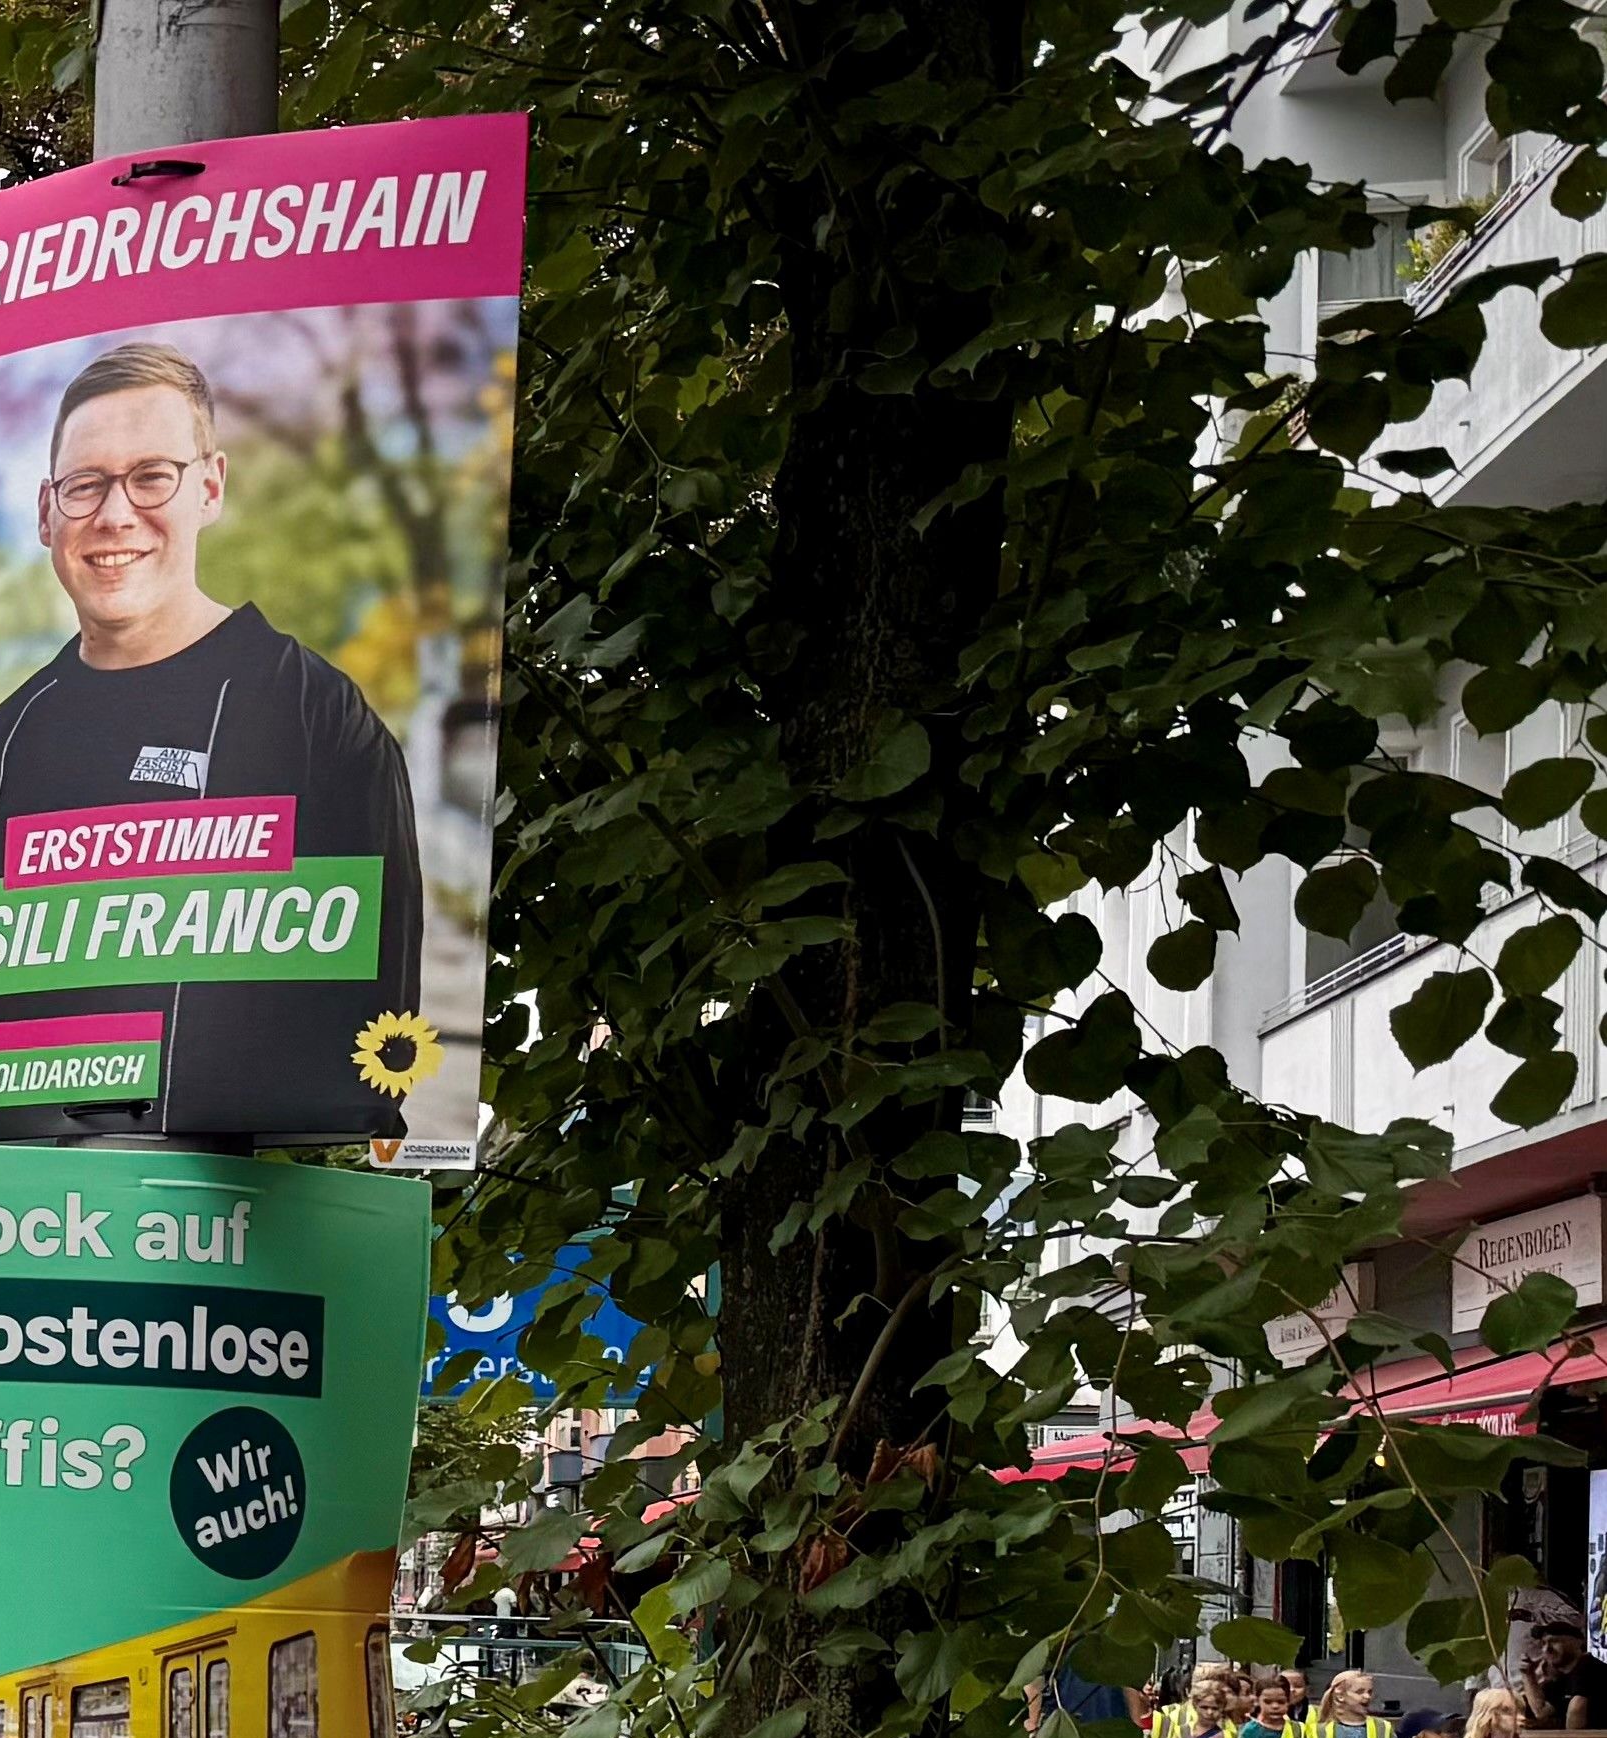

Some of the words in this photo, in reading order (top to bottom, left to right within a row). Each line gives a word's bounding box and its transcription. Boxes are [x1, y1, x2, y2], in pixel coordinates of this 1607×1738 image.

[132, 769, 182, 785] ACTION
[159, 748, 191, 762] ANTI
[17, 814, 280, 876] ERSTSTIMME
[85, 884, 361, 962] FRANCO
[135, 1200, 252, 1266] auf
[1478, 1220, 1572, 1270] REGENBOGEN
[196, 1438, 273, 1495] Wir
[194, 1473, 301, 1550] auch!
